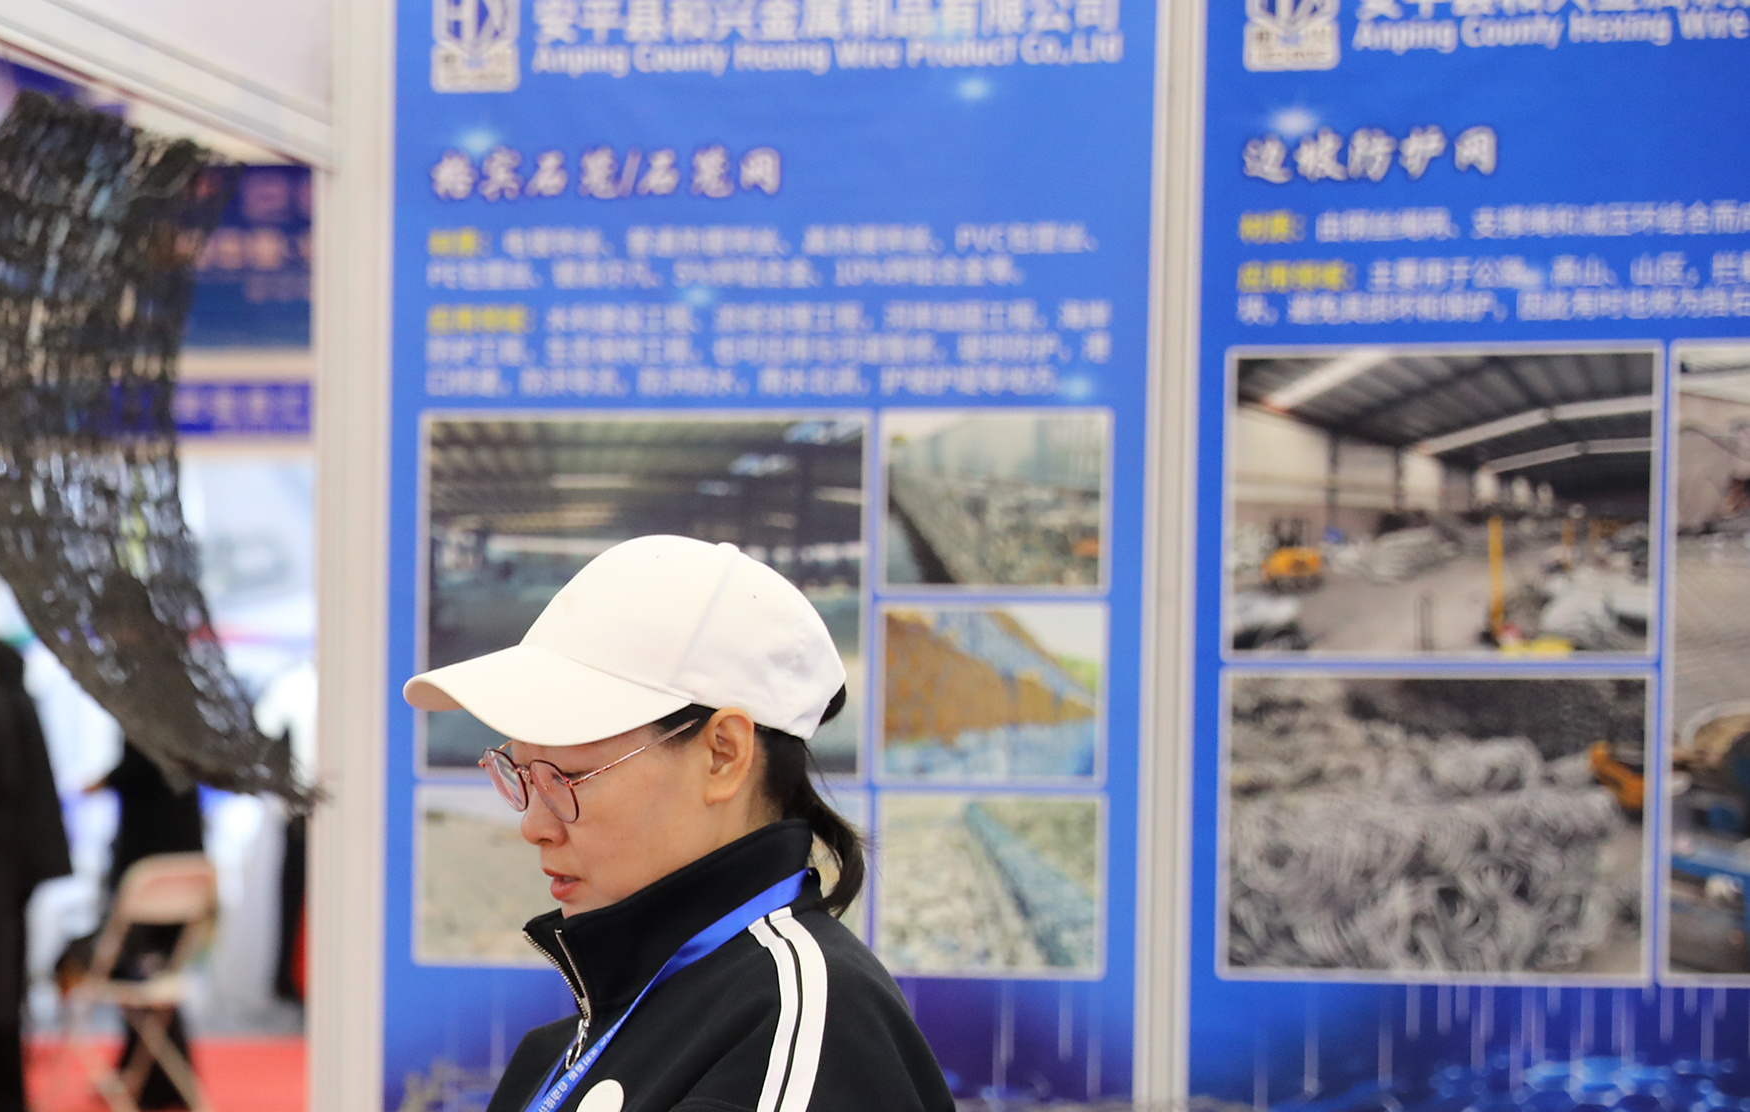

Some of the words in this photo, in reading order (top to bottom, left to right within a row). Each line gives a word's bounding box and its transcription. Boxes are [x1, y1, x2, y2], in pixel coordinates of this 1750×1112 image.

[1354, 18, 1457, 53] Anping
[1462, 15, 1563, 49] County
[1569, 12, 1672, 45] Hexing
[1680, 10, 1750, 40] Wire
[533, 43, 629, 76] Anping
[634, 42, 729, 75] County
[734, 40, 830, 75] Hexing
[835, 39, 899, 70] Wire
[906, 36, 1014, 67] Product
